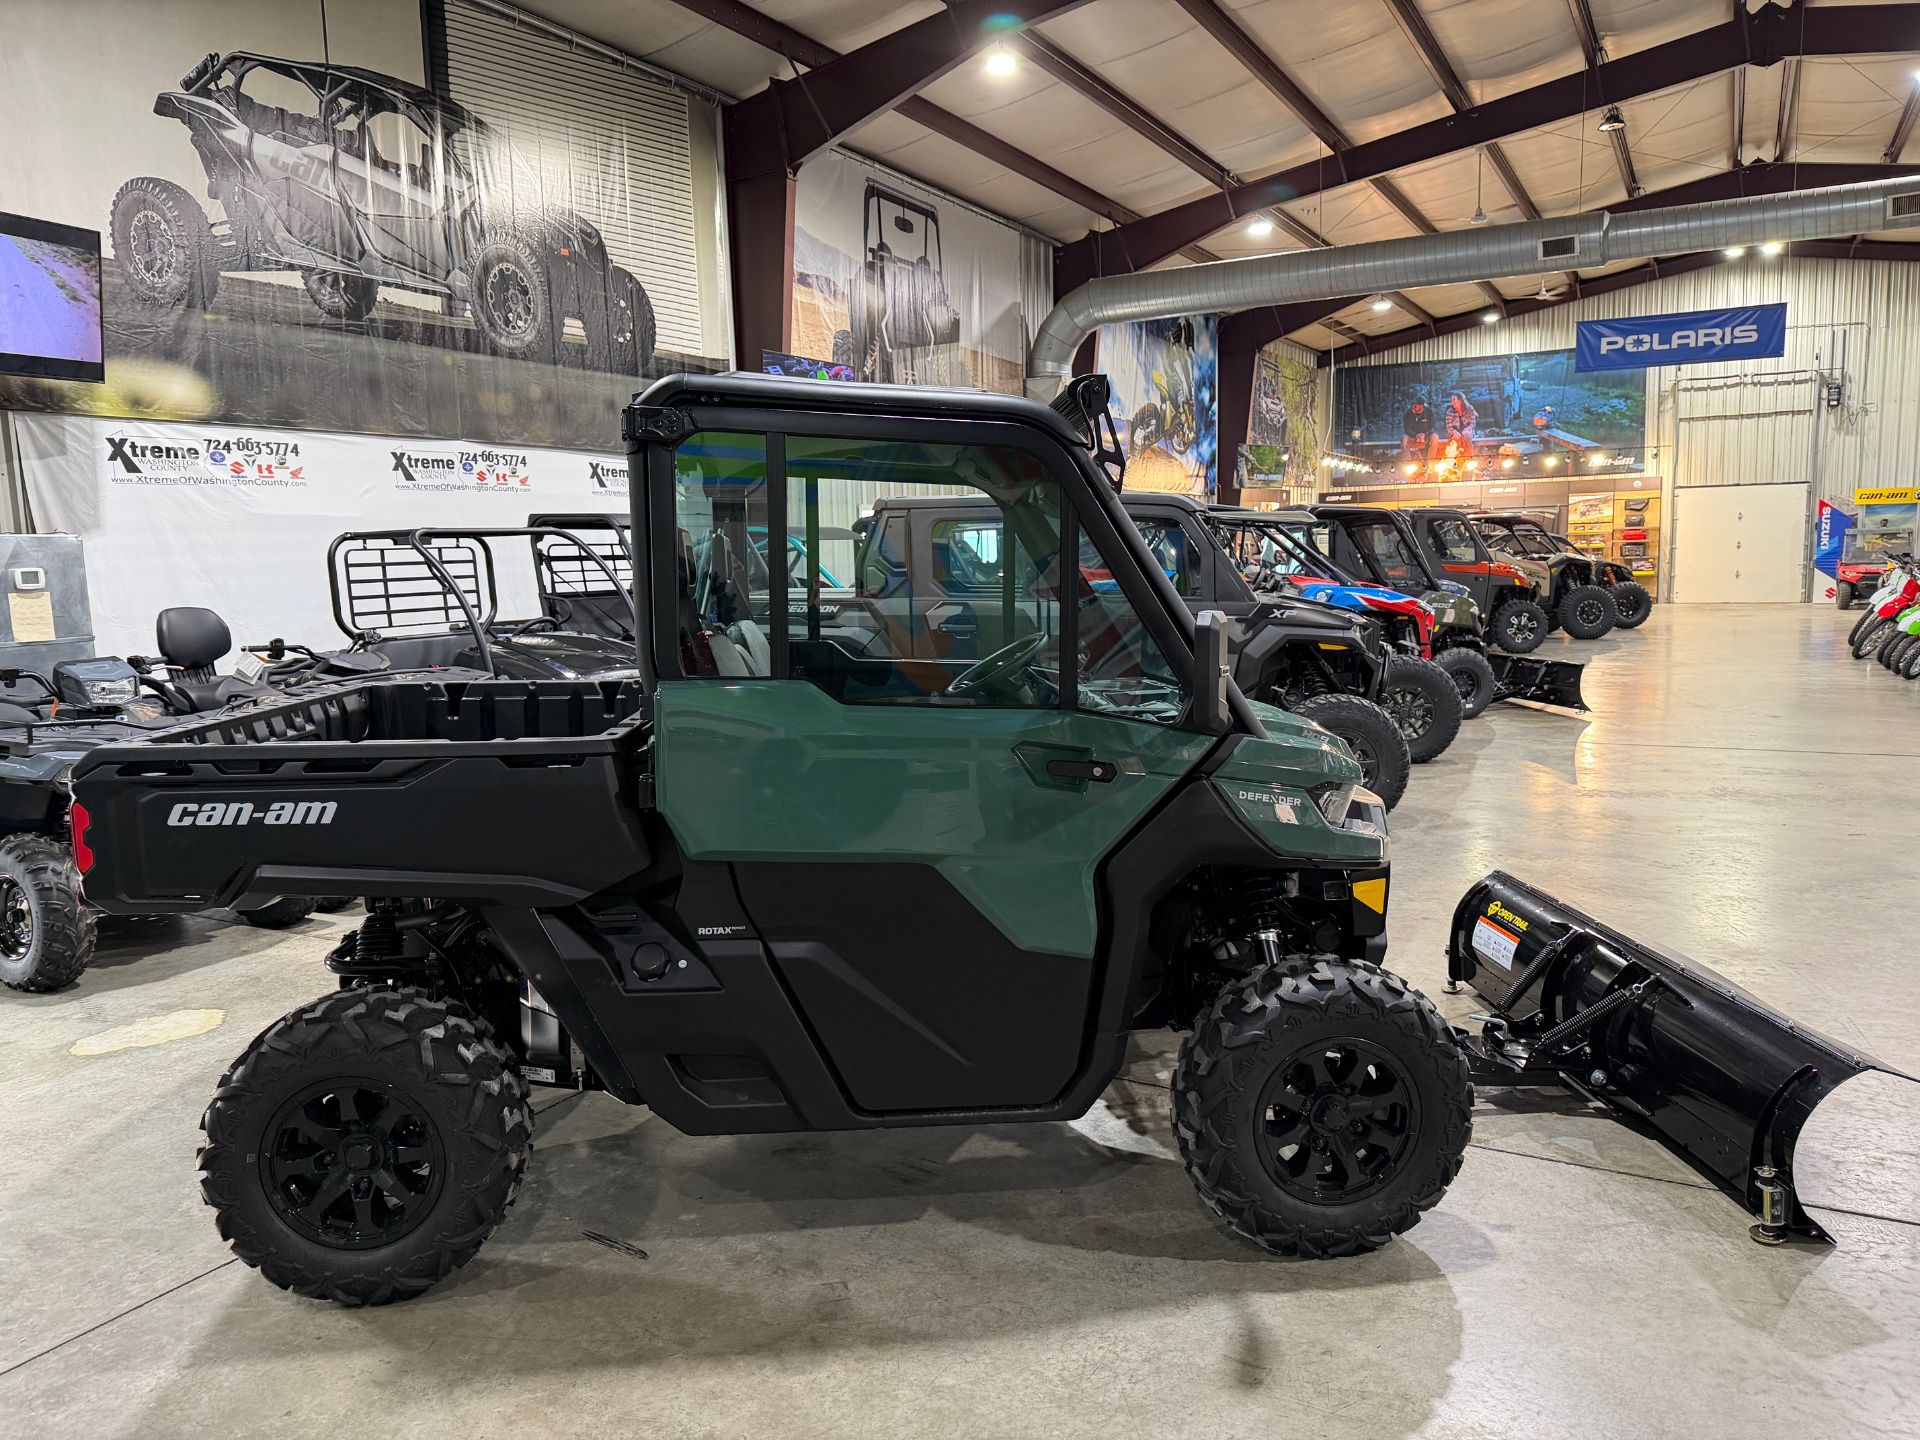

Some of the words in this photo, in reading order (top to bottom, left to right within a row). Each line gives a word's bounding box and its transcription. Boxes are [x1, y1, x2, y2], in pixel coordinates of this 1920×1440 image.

[1600, 325, 1759, 354] POLARIS
[105, 437, 200, 474] Xtreme
[203, 437, 300, 457] 724-663-5774
[137, 458, 200, 466] WASHINGTON
[390, 452, 456, 481] Xtreme
[458, 450, 528, 467] 724-663-5774
[111, 475, 307, 488] www.XtremeOfWashingtonCounty.com
[589, 462, 629, 488] Xtrem
[1859, 492, 1908, 500] can-am
[1820, 506, 1832, 550] SUZUKI
[1268, 609, 1298, 618] XP
[1239, 791, 1302, 806] DEFENDER
[167, 801, 338, 826] can-am
[1498, 908, 1515, 922] OPEN
[698, 927, 732, 935] ROTAX
